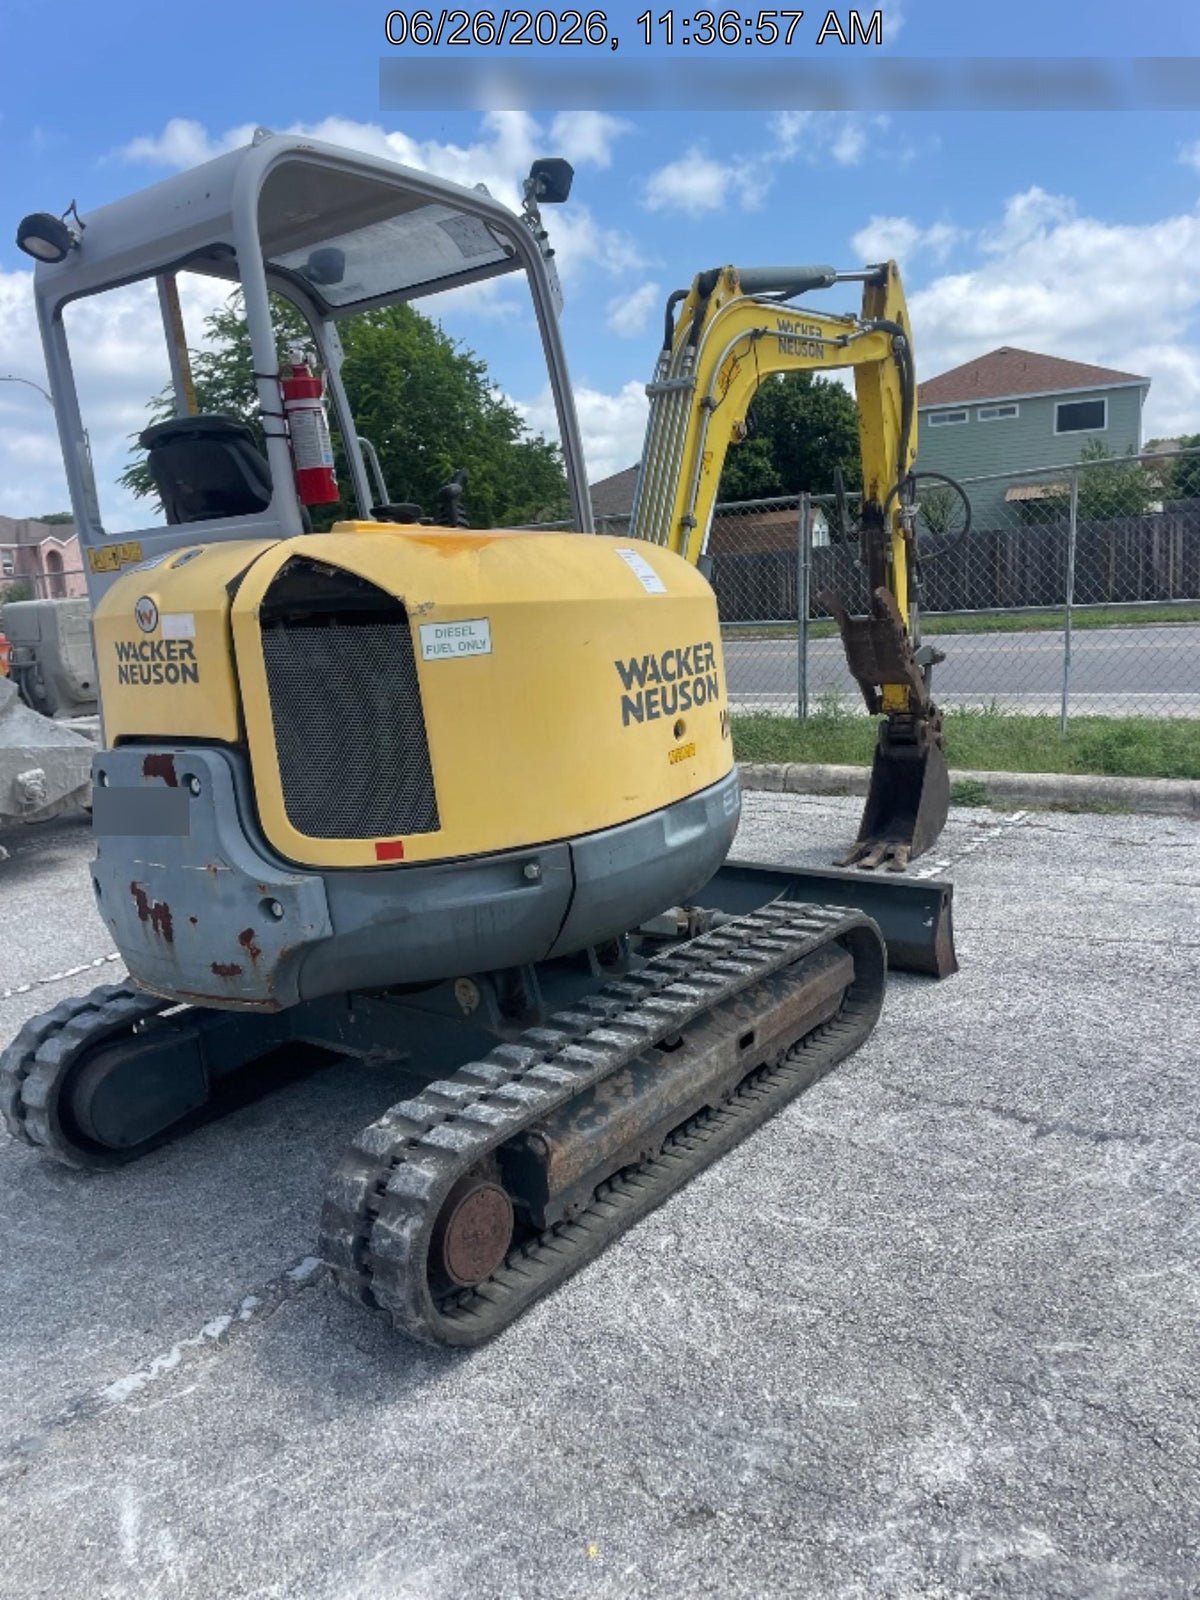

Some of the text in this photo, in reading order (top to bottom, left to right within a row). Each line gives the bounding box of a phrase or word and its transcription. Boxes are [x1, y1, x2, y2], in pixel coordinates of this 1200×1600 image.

[776, 317, 823, 338] WACKER
[778, 337, 825, 360] NEUSON
[434, 625, 477, 640] DIESEL
[114, 639, 197, 662] WACKER
[425, 640, 487, 655] FUEL ONLY
[117, 662, 200, 685] NEUSON
[614, 641, 717, 691] WACKER
[620, 671, 720, 728] NEUSON
